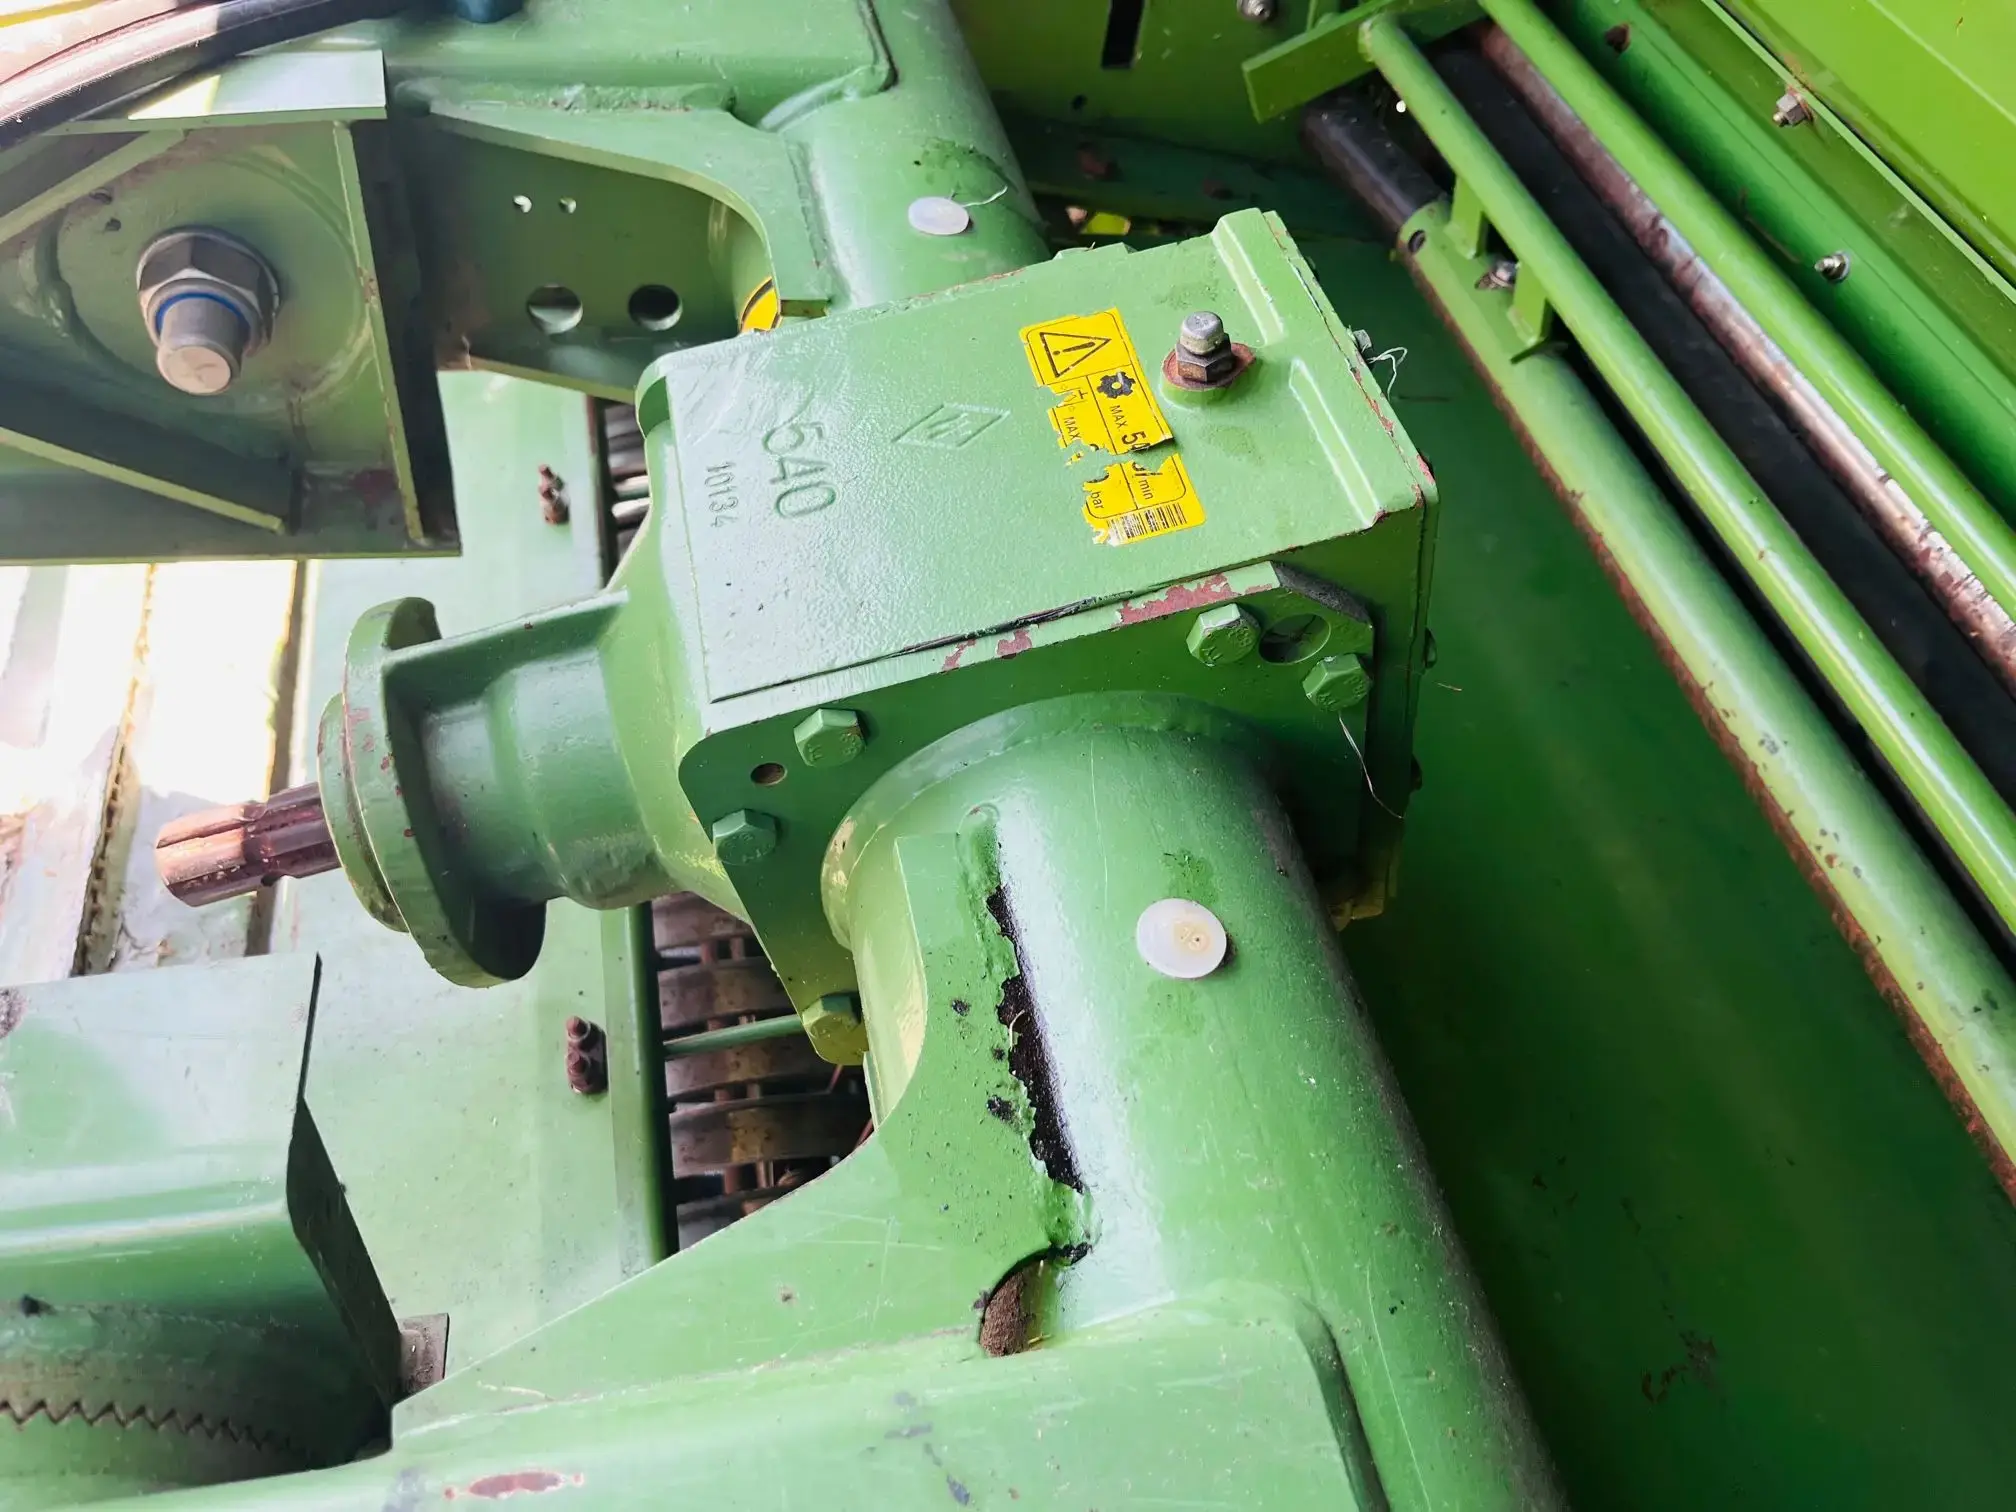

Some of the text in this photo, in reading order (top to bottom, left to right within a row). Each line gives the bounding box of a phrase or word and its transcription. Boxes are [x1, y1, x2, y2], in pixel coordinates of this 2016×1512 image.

[1109, 404, 1128, 431] MAX.
[762, 421, 837, 519] 540
[1090, 491, 1104, 511] bar
